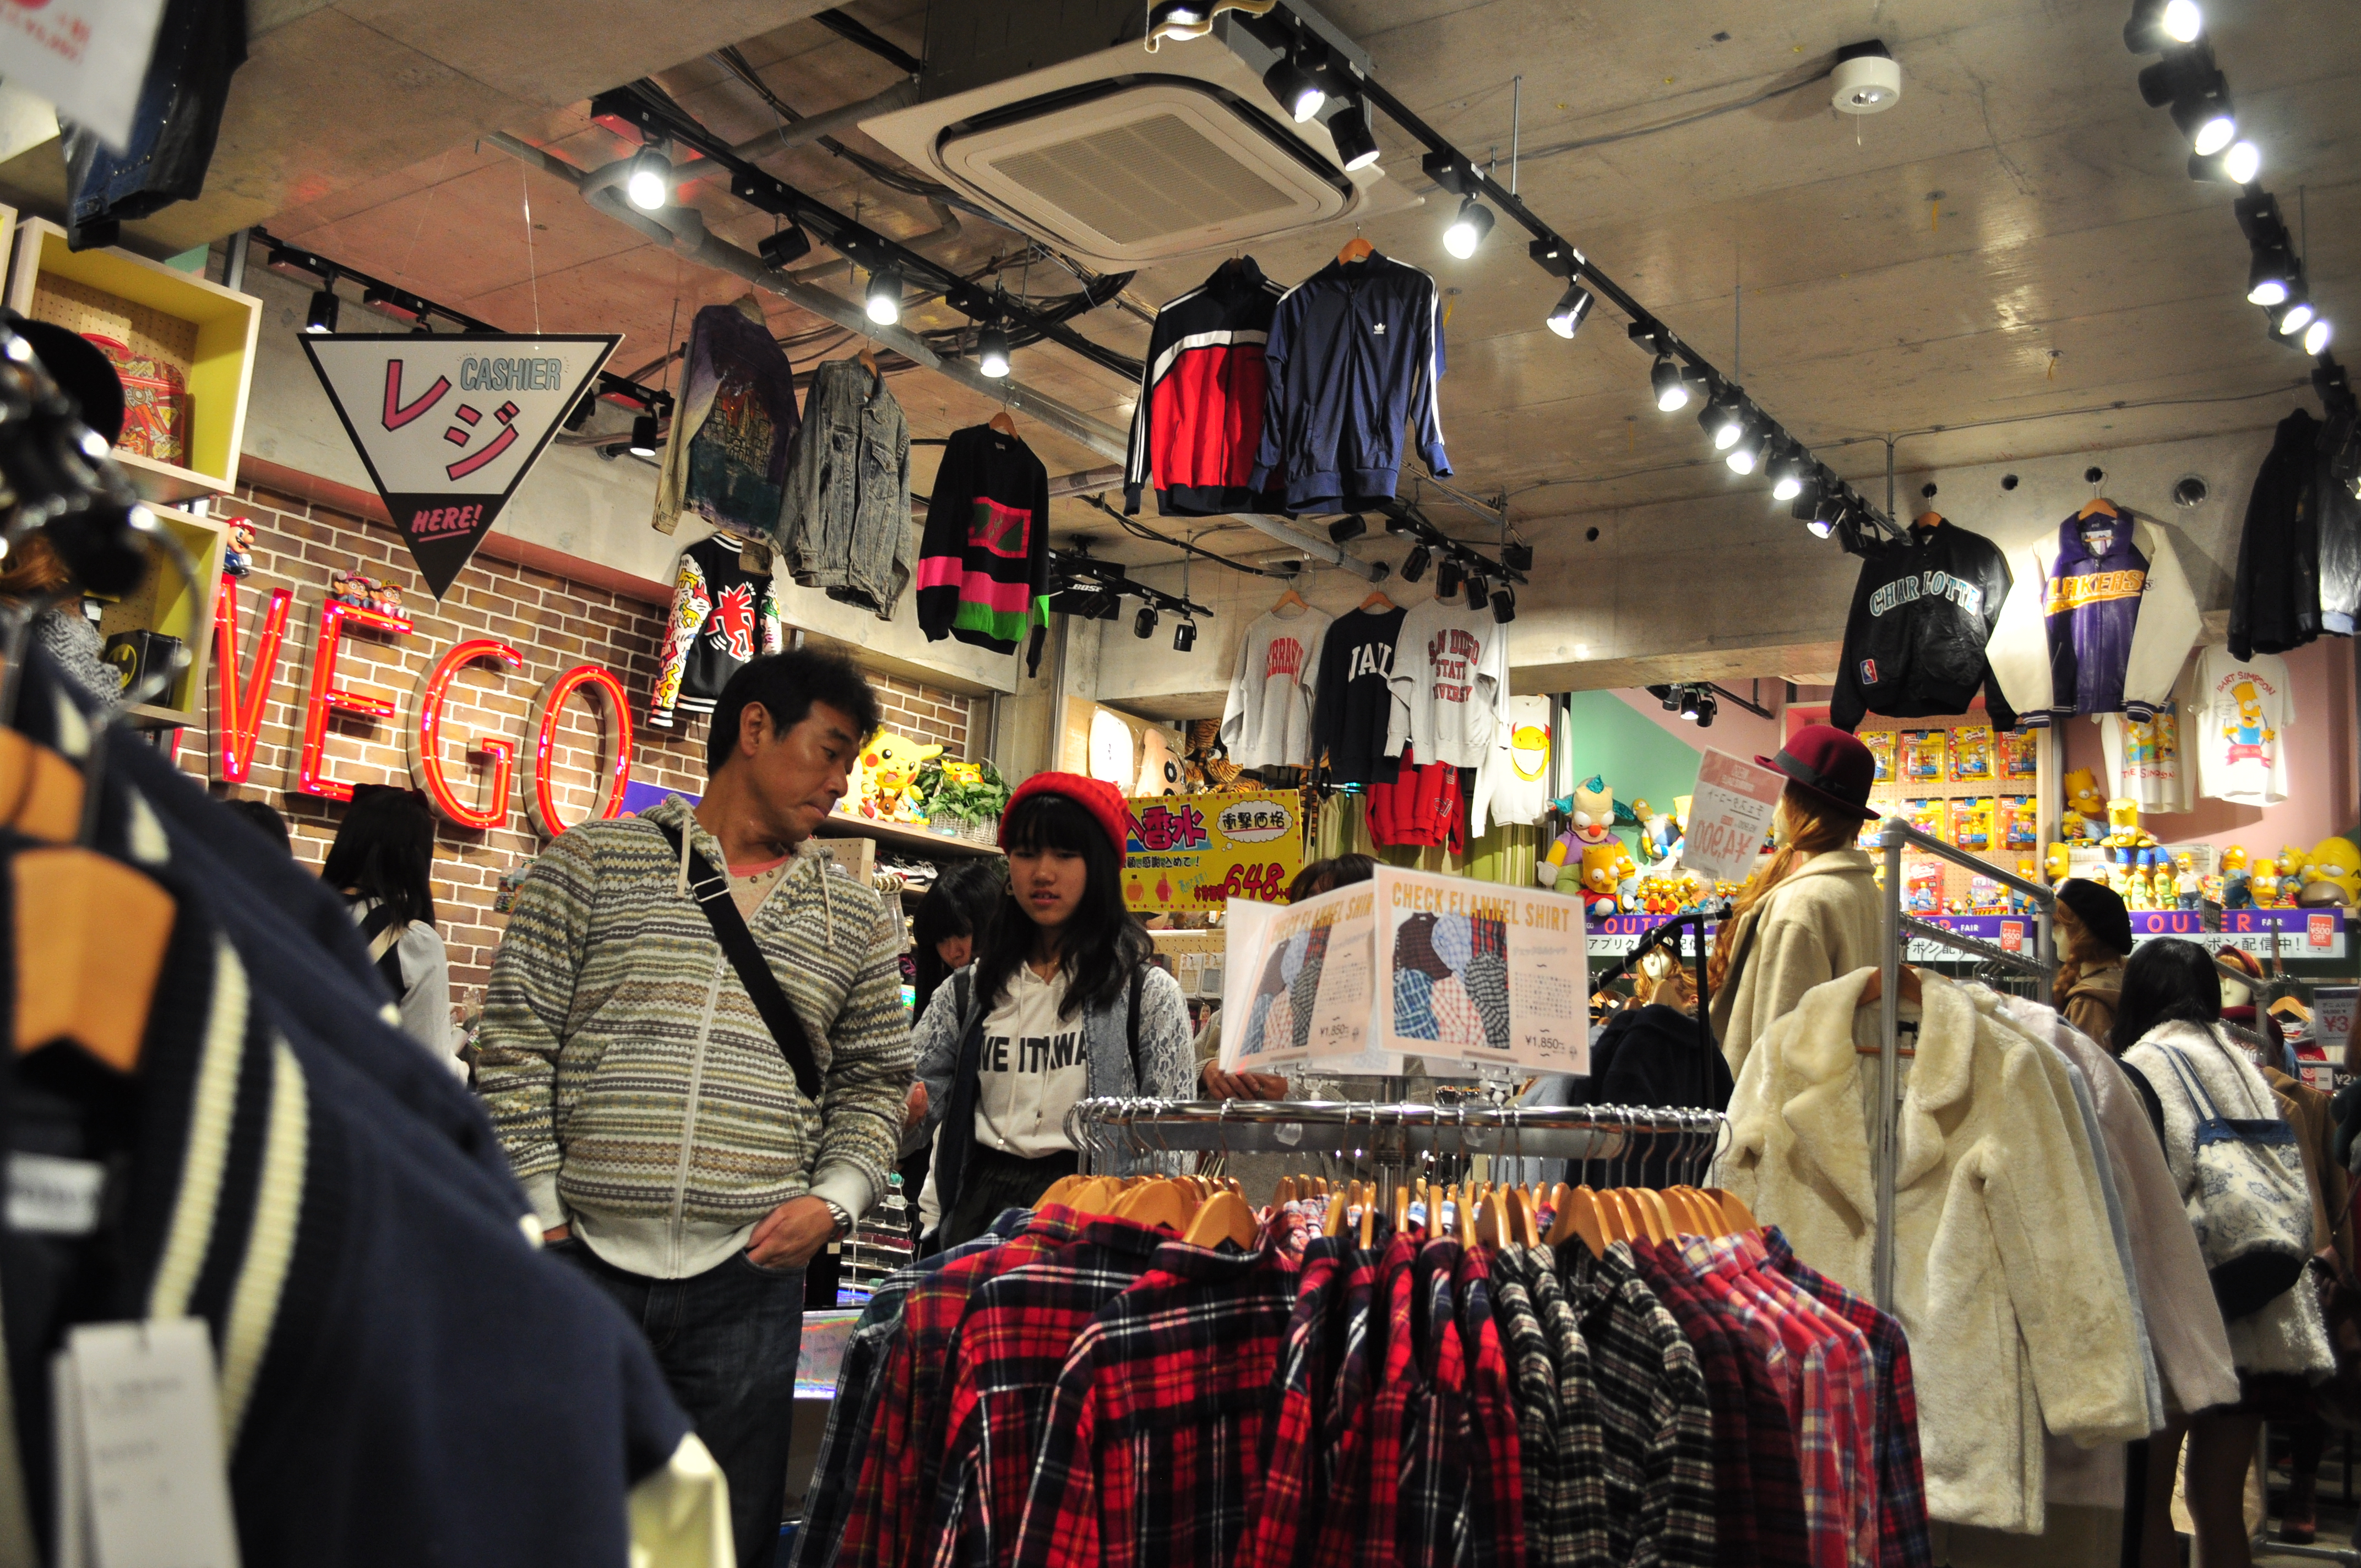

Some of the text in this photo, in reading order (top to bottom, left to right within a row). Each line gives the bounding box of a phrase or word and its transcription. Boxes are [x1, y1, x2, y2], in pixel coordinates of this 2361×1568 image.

[460, 358, 561, 391] CASHIER
[382, 358, 520, 481] レジ
[411, 504, 483, 533] HERE!
[1224, 863, 1285, 902] 648
[1346, 892, 1374, 921] SHIR
[1392, 882, 1569, 932] CHECK FLANNEL SHIRT
[2310, 927, 2330, 935] ¥500
